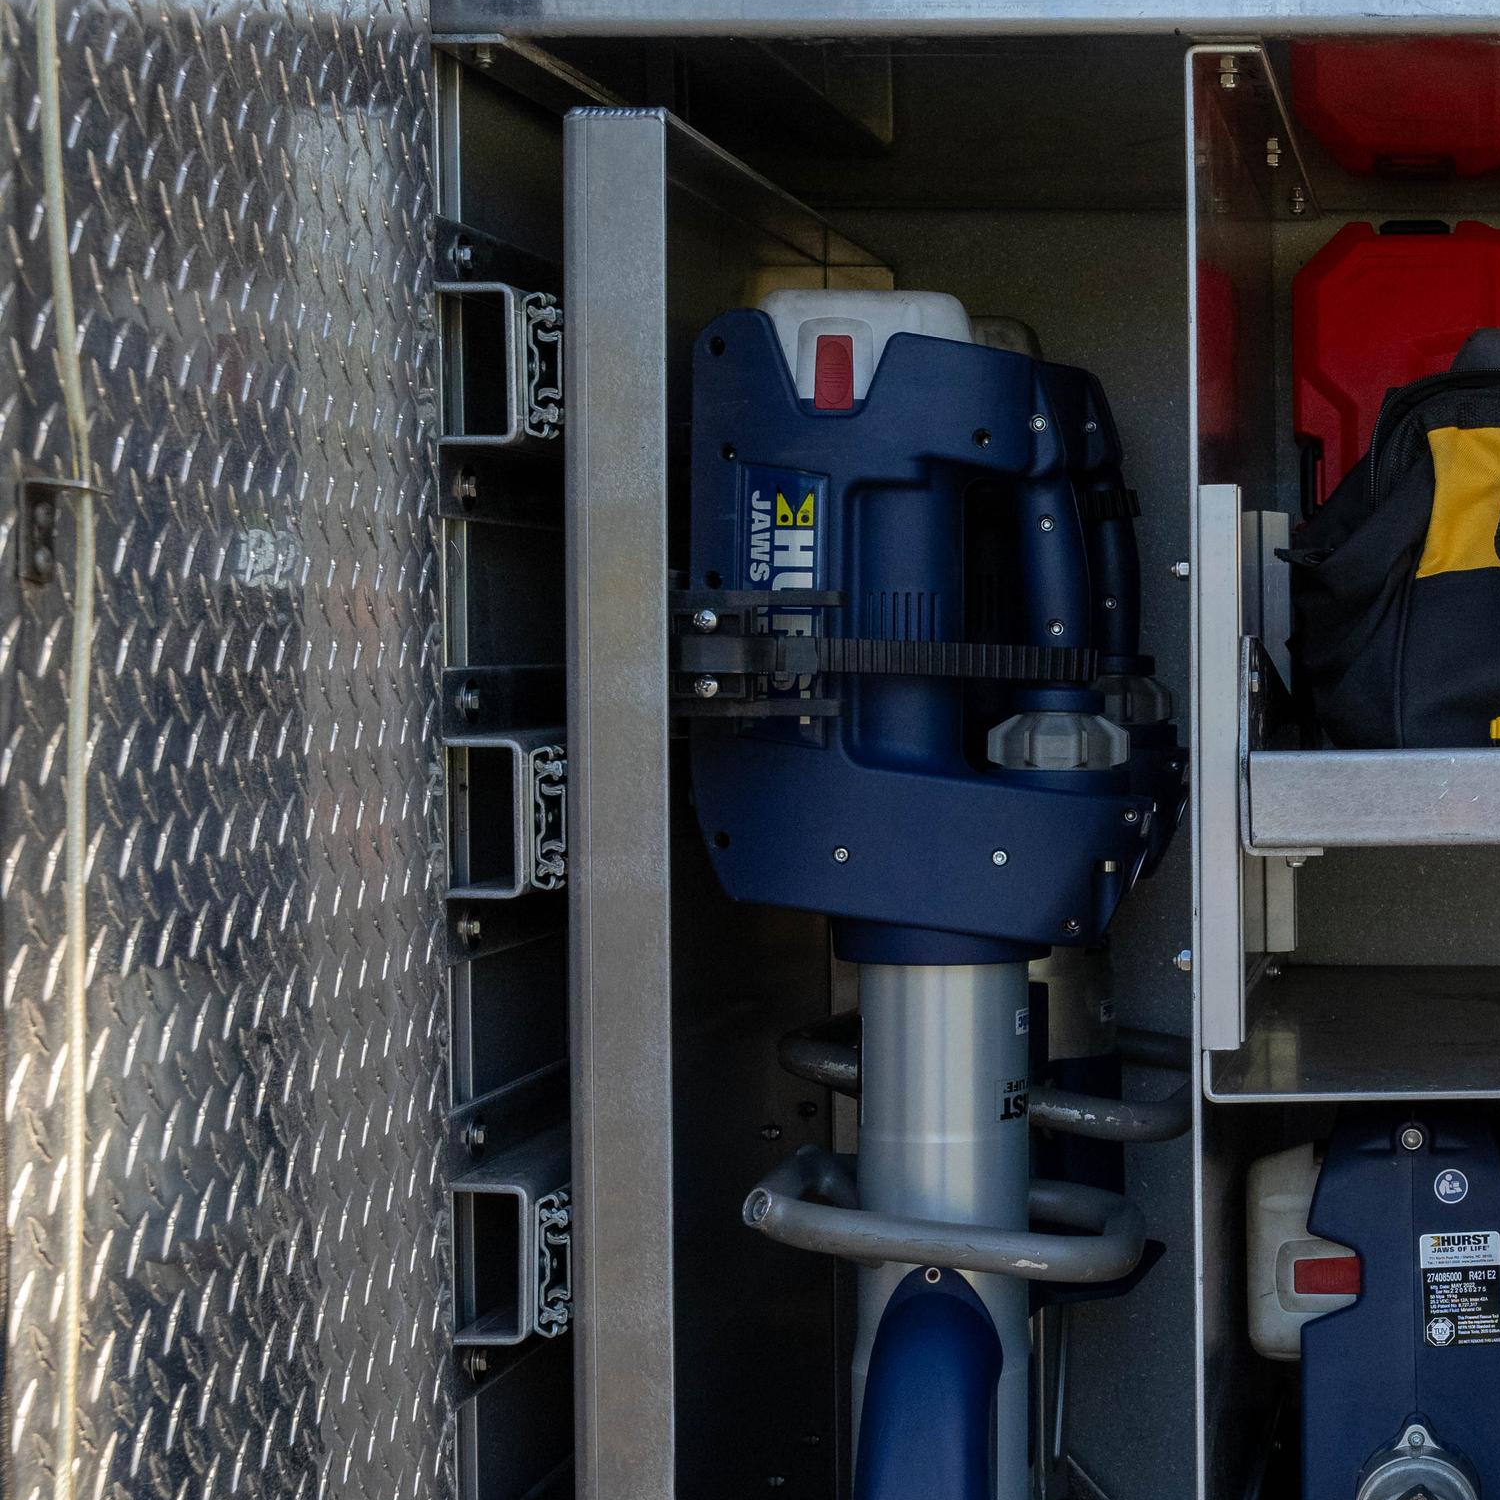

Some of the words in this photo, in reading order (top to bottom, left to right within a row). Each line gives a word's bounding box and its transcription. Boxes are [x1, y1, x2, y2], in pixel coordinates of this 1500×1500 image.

[750, 489, 771, 582] JAWS
[1441, 1234, 1490, 1247] HURST
[1468, 1270, 1485, 1281] R421
[1487, 1269, 1497, 1280] E2
